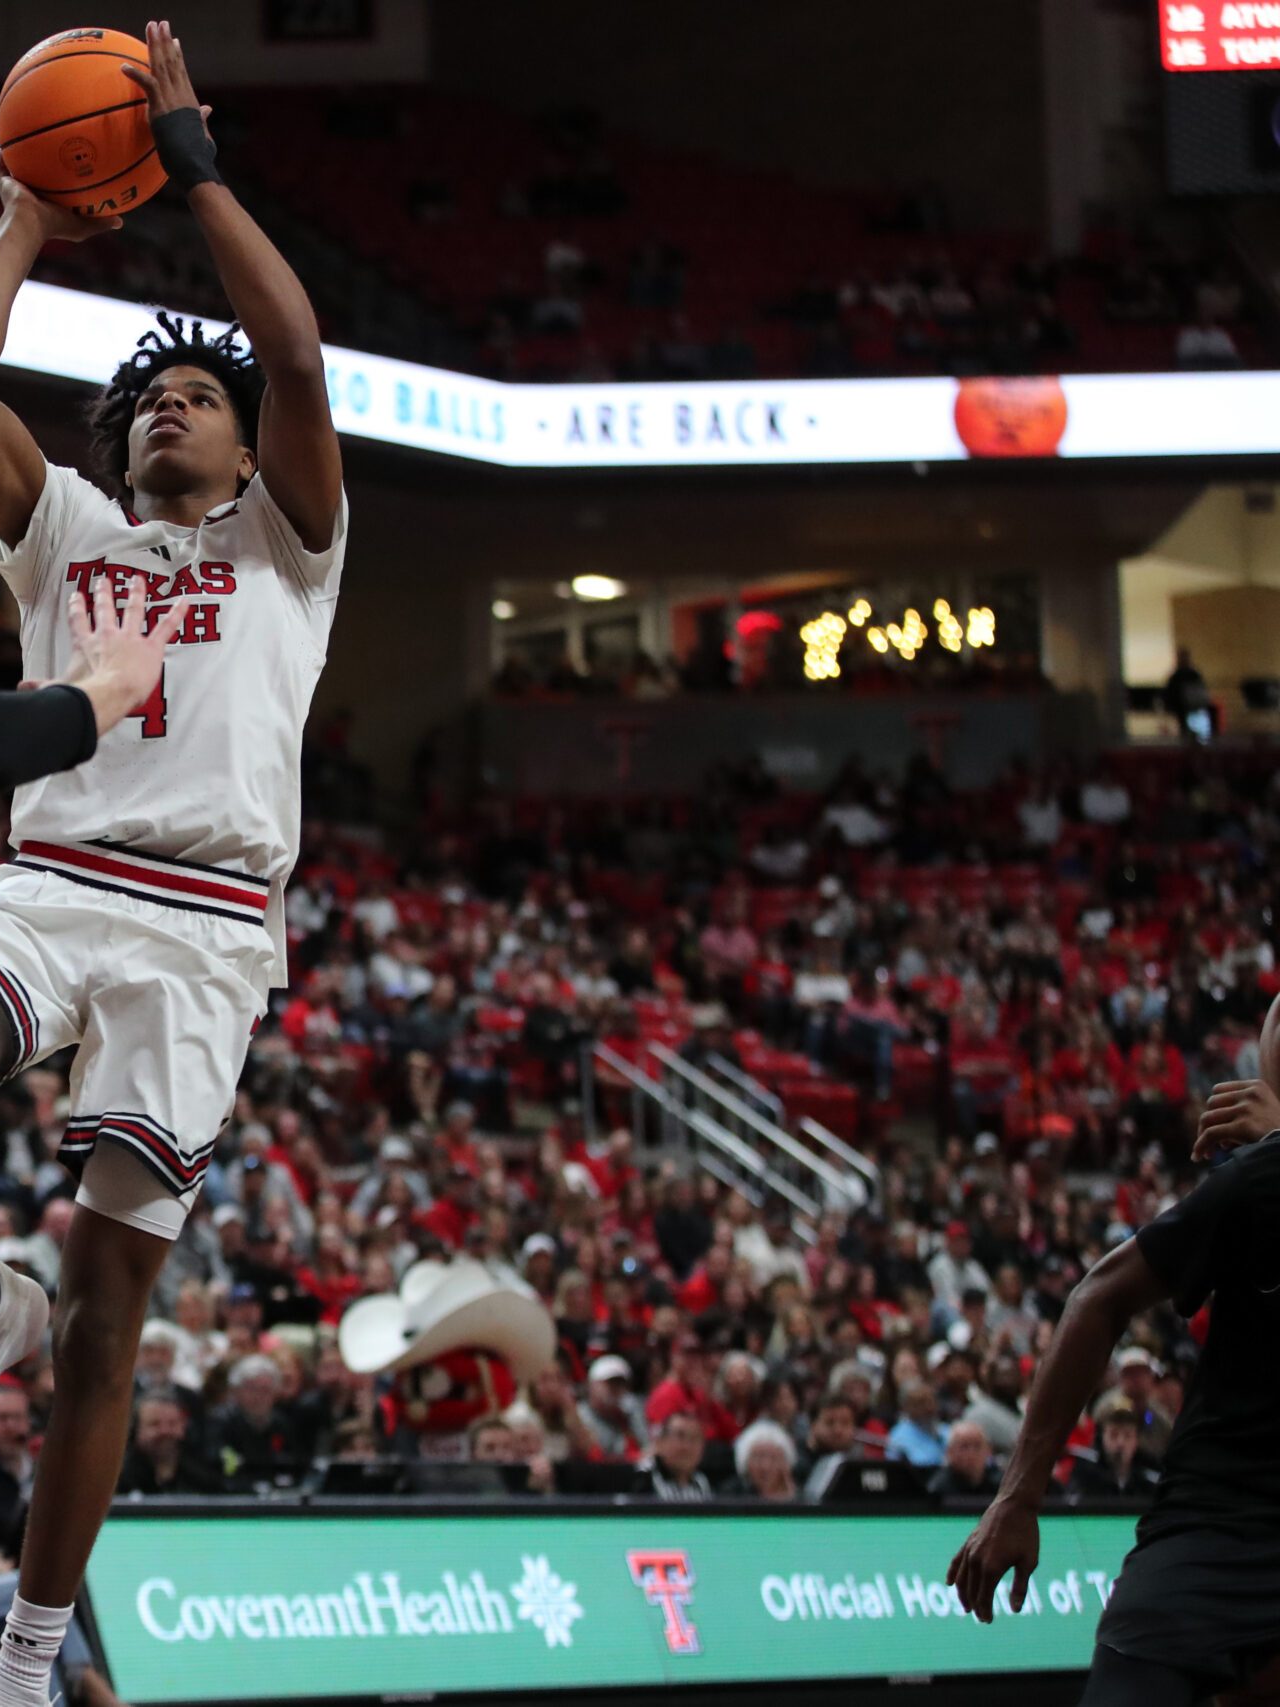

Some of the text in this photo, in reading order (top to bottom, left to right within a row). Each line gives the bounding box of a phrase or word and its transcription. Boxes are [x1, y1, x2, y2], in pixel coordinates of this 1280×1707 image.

[392, 379, 508, 446] BALLS
[565, 402, 645, 448] ARE
[672, 399, 788, 447] BACK
[66, 556, 237, 603] TEXAS
[760, 1572, 896, 1622] Official
[1048, 1570, 1084, 1615] of
